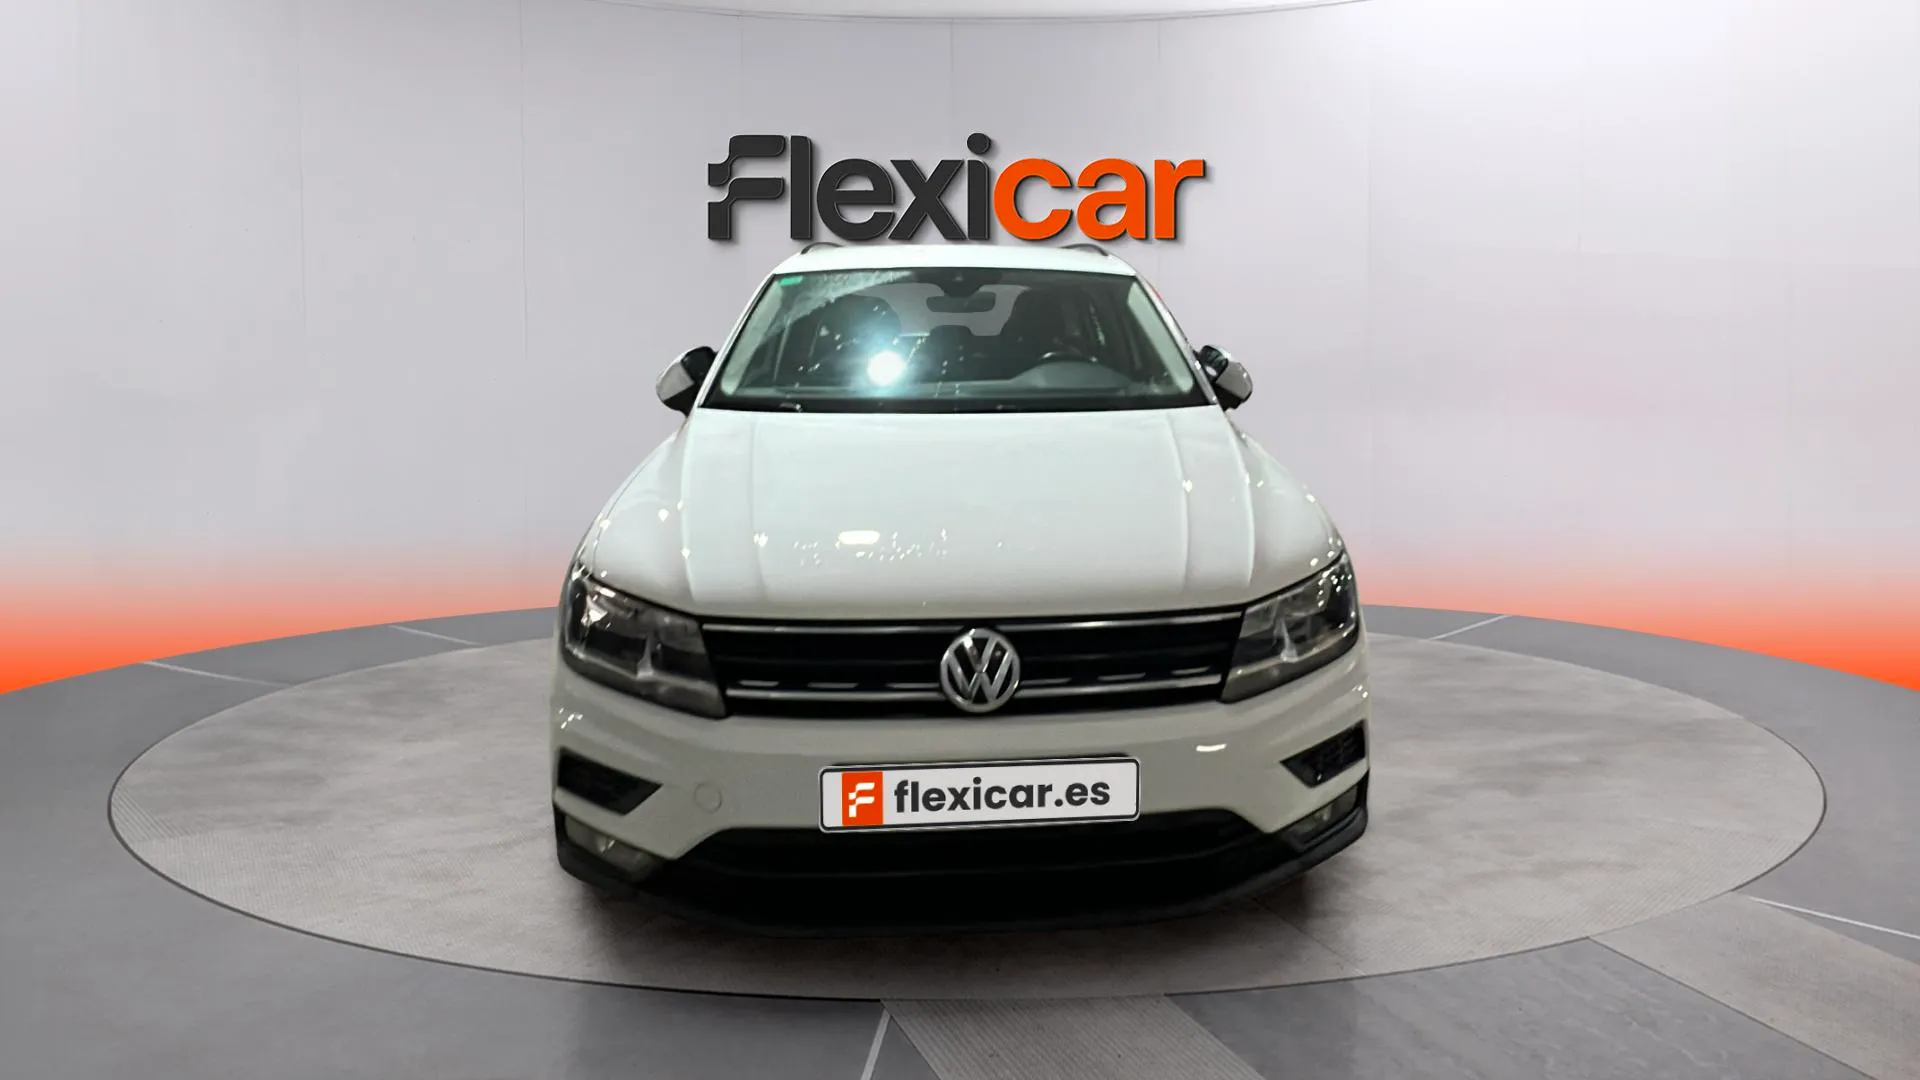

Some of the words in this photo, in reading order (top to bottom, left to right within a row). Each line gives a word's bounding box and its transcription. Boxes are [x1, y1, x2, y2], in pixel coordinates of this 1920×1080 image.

[707, 132, 1206, 241] Flexicar
[943, 629, 1017, 710] VW
[894, 777, 1111, 813] flexicar.es
